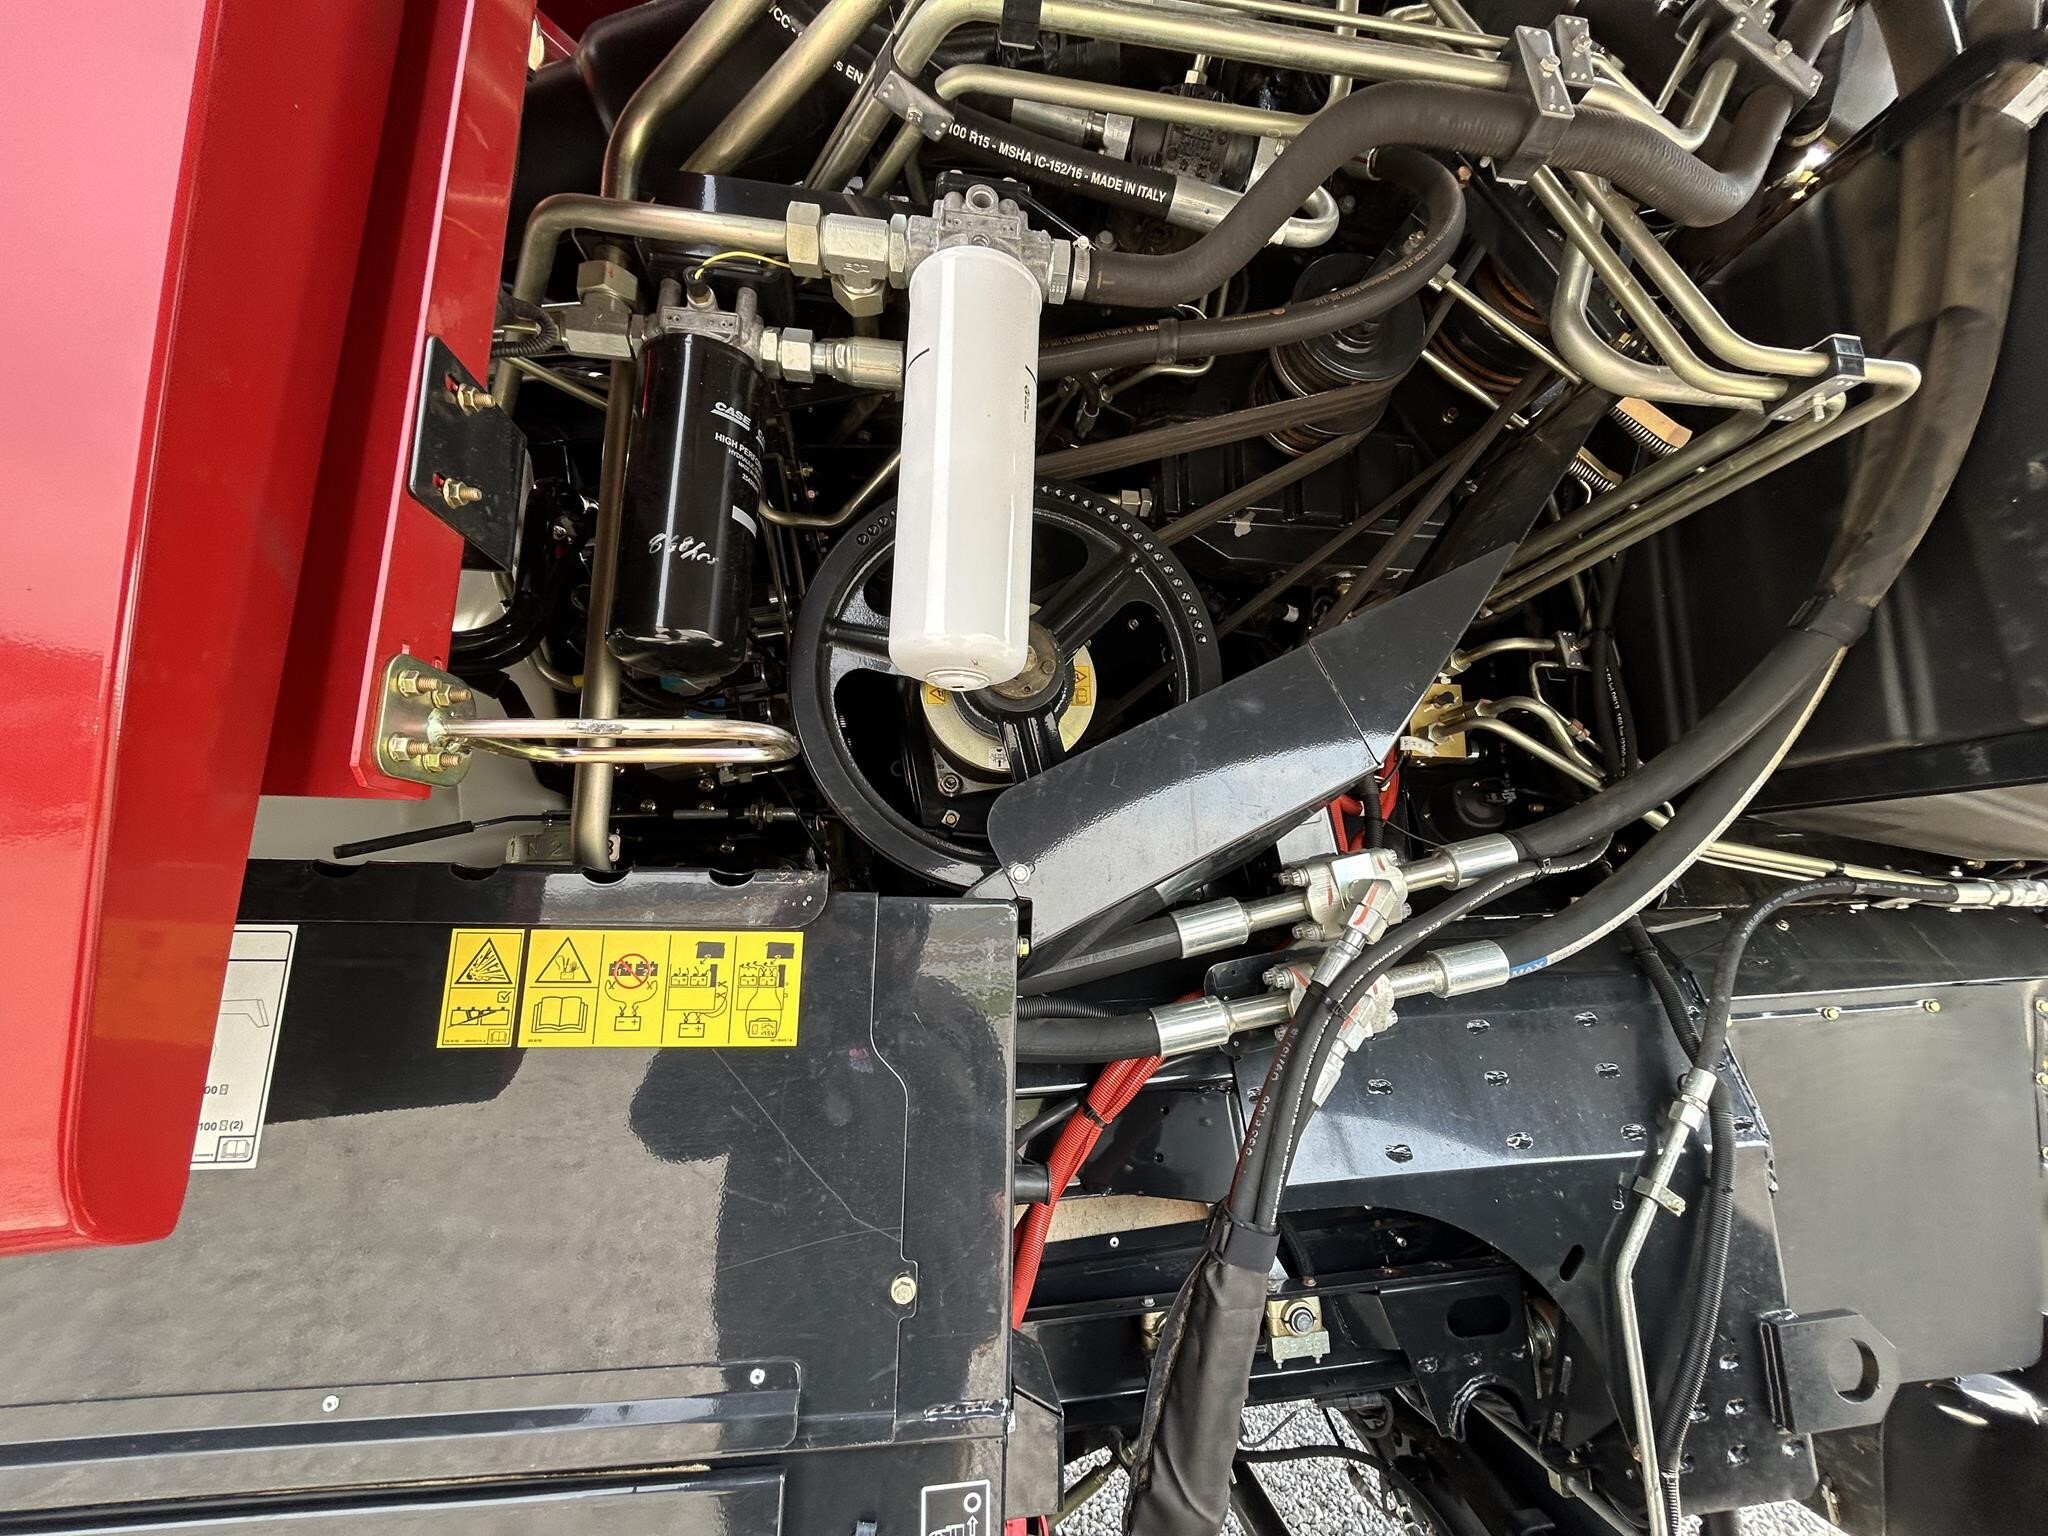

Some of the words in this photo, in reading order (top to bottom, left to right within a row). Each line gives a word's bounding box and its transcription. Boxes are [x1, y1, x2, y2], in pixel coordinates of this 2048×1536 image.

[968, 130, 991, 149] R15
[998, 141, 1032, 165] MSHA
[1033, 154, 1084, 180] IC-152/16
[1090, 171, 1123, 192] MADE
[1123, 181, 1137, 196] IN
[1137, 184, 1168, 203] ITALY
[714, 401, 752, 427] CASE
[714, 431, 739, 449] HIGH
[229, 1120, 244, 1132] (2)
